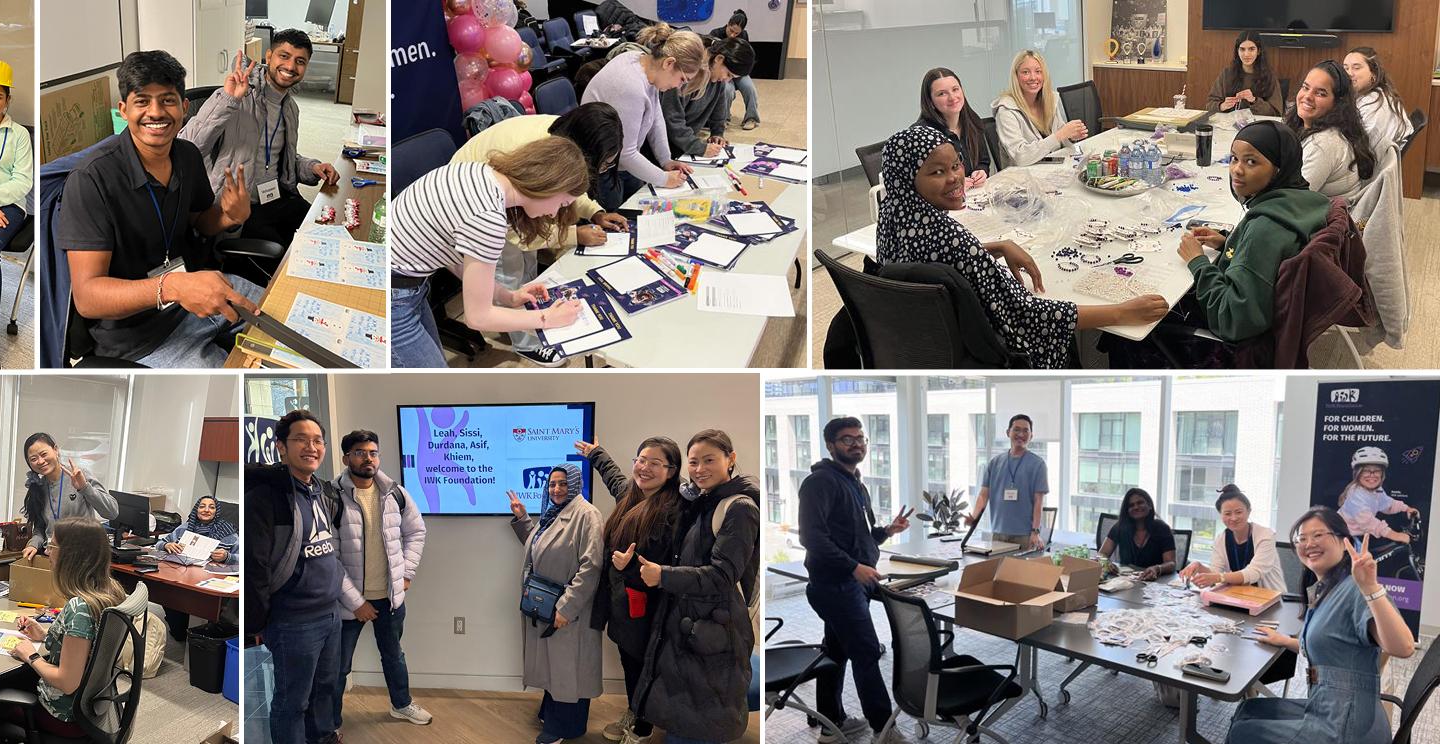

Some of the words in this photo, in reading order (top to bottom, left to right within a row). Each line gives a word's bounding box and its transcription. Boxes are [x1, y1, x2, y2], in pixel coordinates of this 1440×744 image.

[551, 426, 580, 435] MARY'S
[1323, 424, 1339, 432] FOR
[1341, 424, 1374, 432] WOMEN.
[433, 429, 458, 438] Leah,
[459, 428, 483, 438] Sissi,
[1357, 434, 1392, 442] FUTURE.
[428, 441, 468, 450] Durdana,
[470, 440, 490, 450] Asif,
[444, 452, 474, 462] Khiem,
[426, 465, 464, 473] welcome
[466, 465, 476, 473] to
[478, 464, 493, 473] the
[424, 476, 441, 484] IWK
[443, 476, 496, 484] Foundation!
[304, 540, 334, 558] Reeb
[1385, 585, 1406, 593] NOW
